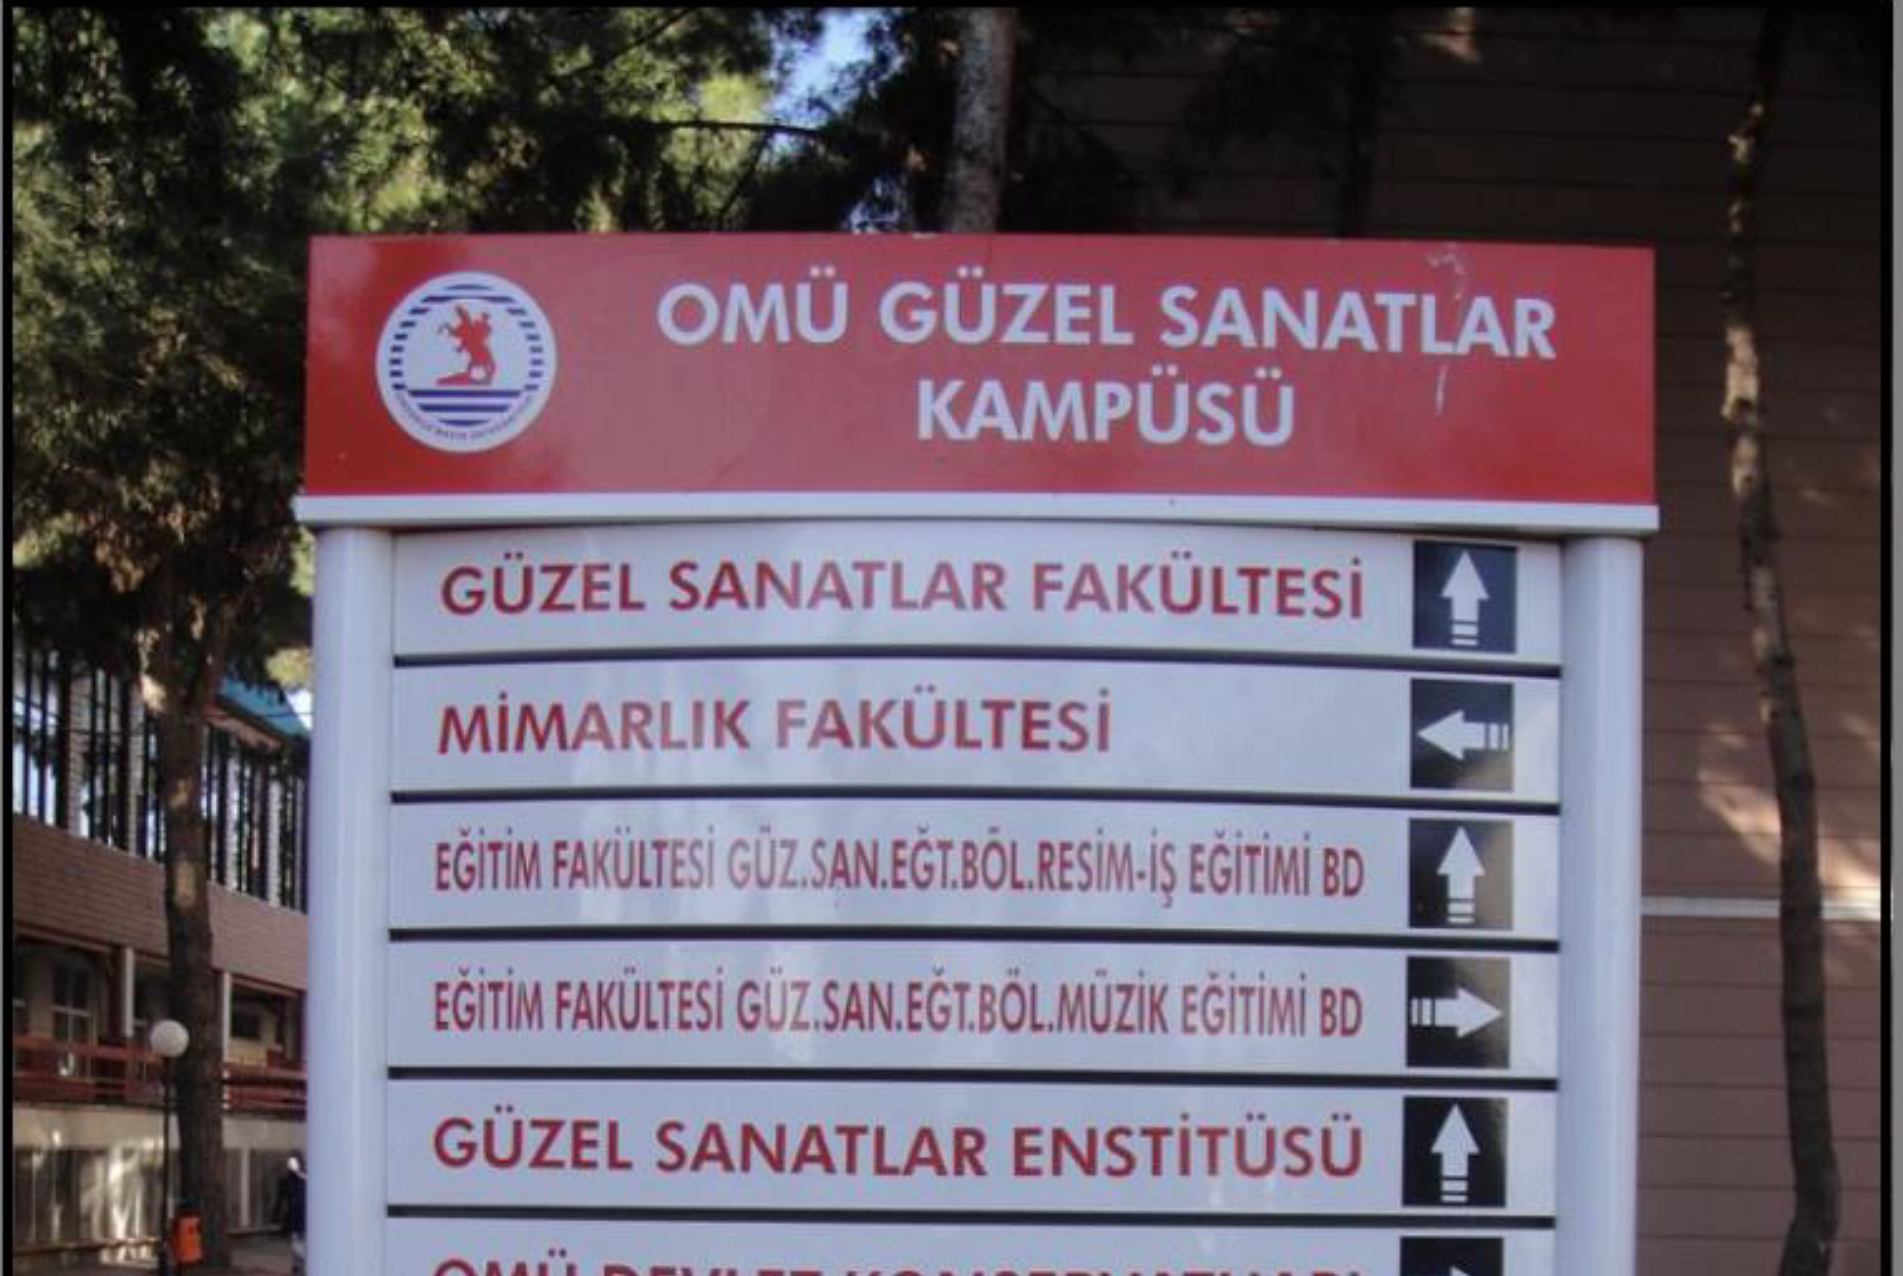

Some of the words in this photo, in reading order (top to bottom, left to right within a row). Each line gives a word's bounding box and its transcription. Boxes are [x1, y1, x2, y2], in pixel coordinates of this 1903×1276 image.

[657, 265, 848, 345] OMÜ
[878, 265, 1134, 344] GÜZEL
[1160, 285, 1556, 359] SANATLAR
[917, 364, 1294, 447] KAMPÜSÜ
[440, 551, 646, 616] GÜZEL
[669, 560, 1006, 611] SANATLAR
[1032, 550, 1363, 618] FAKÜLTESİ
[438, 692, 751, 755] MİMARLIK
[776, 685, 1112, 752] FAKÜLTESİ
[435, 826, 541, 891] EĞİTİM
[553, 825, 714, 890] FAKÜLTESİ
[727, 825, 1177, 907] GÜZ.SAN.EĞT.BÖL.RESİM-İŞ
[1190, 829, 1310, 896] EĞİTİMİ
[1323, 847, 1365, 897] BD
[434, 967, 543, 1031] EĞİTİM
[556, 966, 723, 1030] FAKÜLTESİ
[737, 967, 1168, 1034] GÜZ.SAN.EĞT.BÖL.MÜZİK
[1182, 972, 1305, 1037] EĞİTİMİ
[1320, 988, 1362, 1037] BD
[433, 1105, 632, 1169] GÜZEL
[656, 1121, 987, 1177] SANATLAR
[1012, 1113, 1362, 1178] ENSTİTÜSÜ
